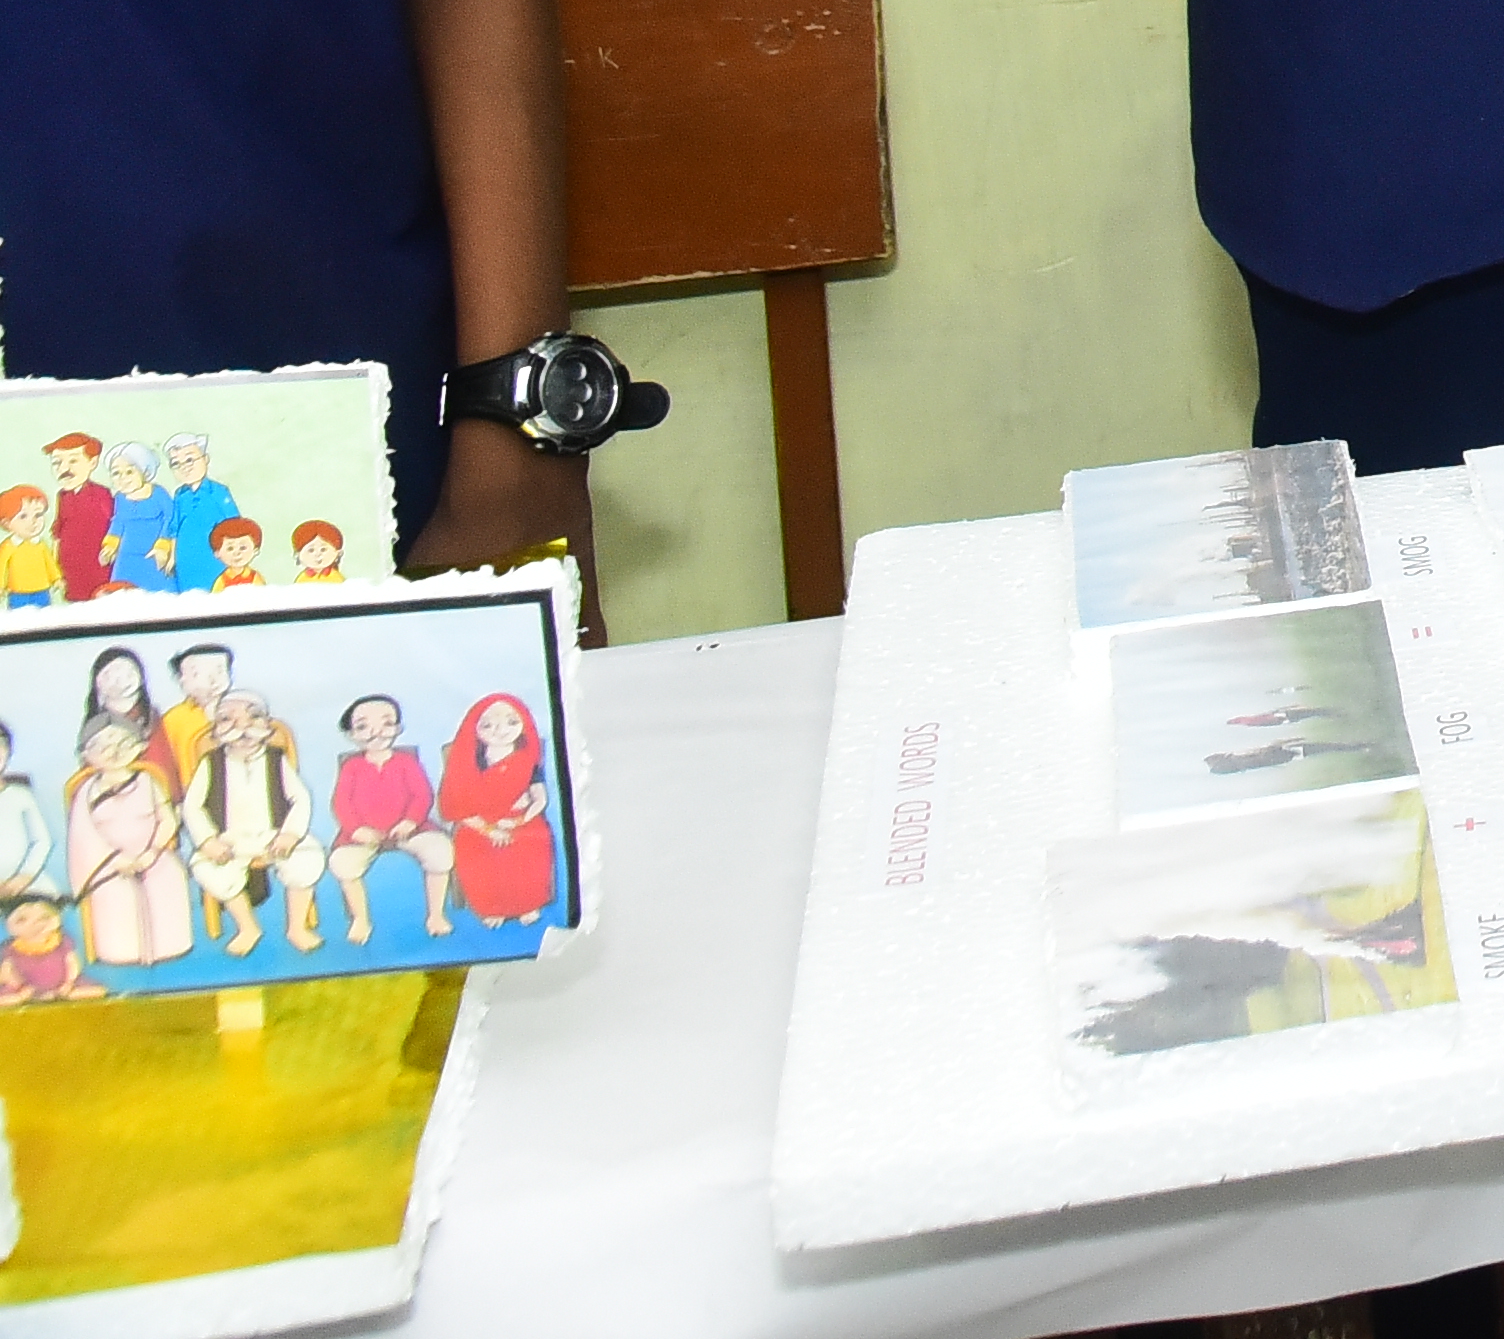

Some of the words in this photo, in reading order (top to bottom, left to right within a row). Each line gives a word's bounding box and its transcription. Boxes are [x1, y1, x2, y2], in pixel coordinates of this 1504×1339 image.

[1403, 534, 1434, 578] SMOG
[897, 721, 941, 793] WORDS
[1441, 710, 1468, 746] FOG
[884, 798, 935, 888] BLENDED
